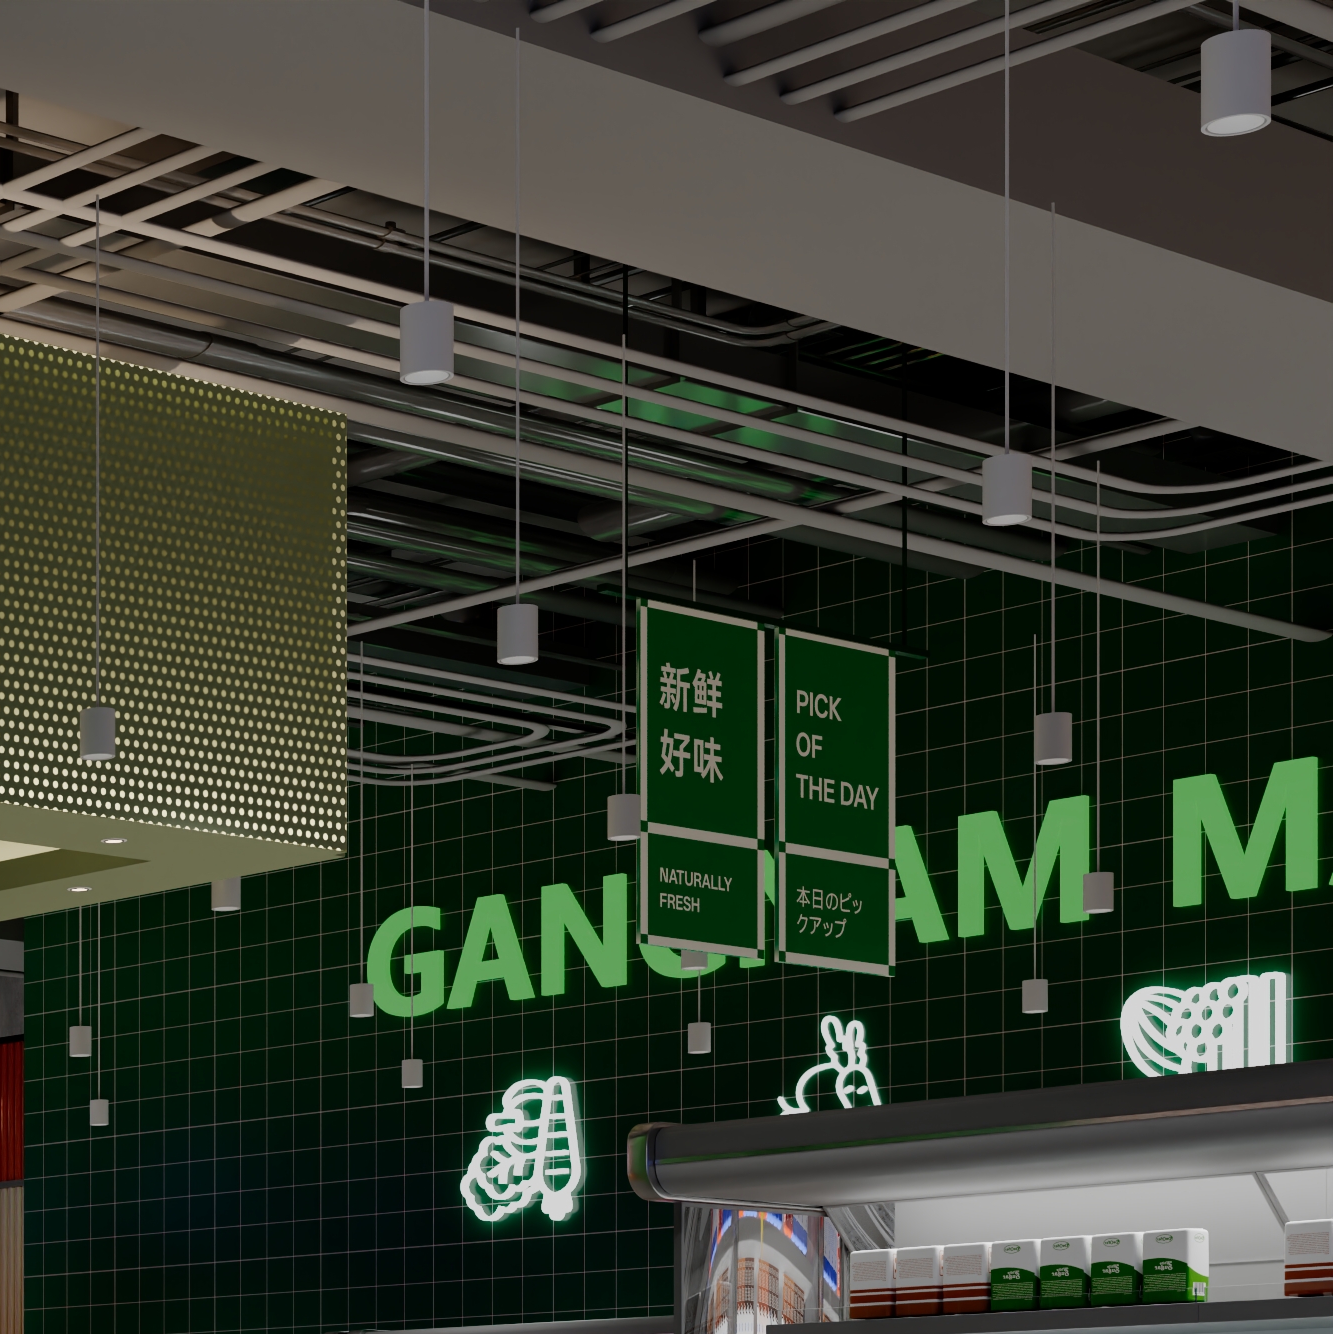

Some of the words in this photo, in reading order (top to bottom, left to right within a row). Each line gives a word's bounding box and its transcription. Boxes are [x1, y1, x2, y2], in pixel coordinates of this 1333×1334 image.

[659, 662, 723, 718] 新鲜
[796, 689, 842, 722] PICK
[659, 728, 724, 784] 好味
[795, 731, 823, 759] OF
[795, 773, 836, 804] THE
[840, 781, 879, 811] DAY
[367, 795, 1091, 1017] GANAM
[1173, 756, 1333, 907] M
[659, 867, 733, 892] NATURALLY
[659, 893, 701, 913] FRESH
[796, 885, 863, 915] 本日のピッ
[796, 913, 847, 938] クアップ
